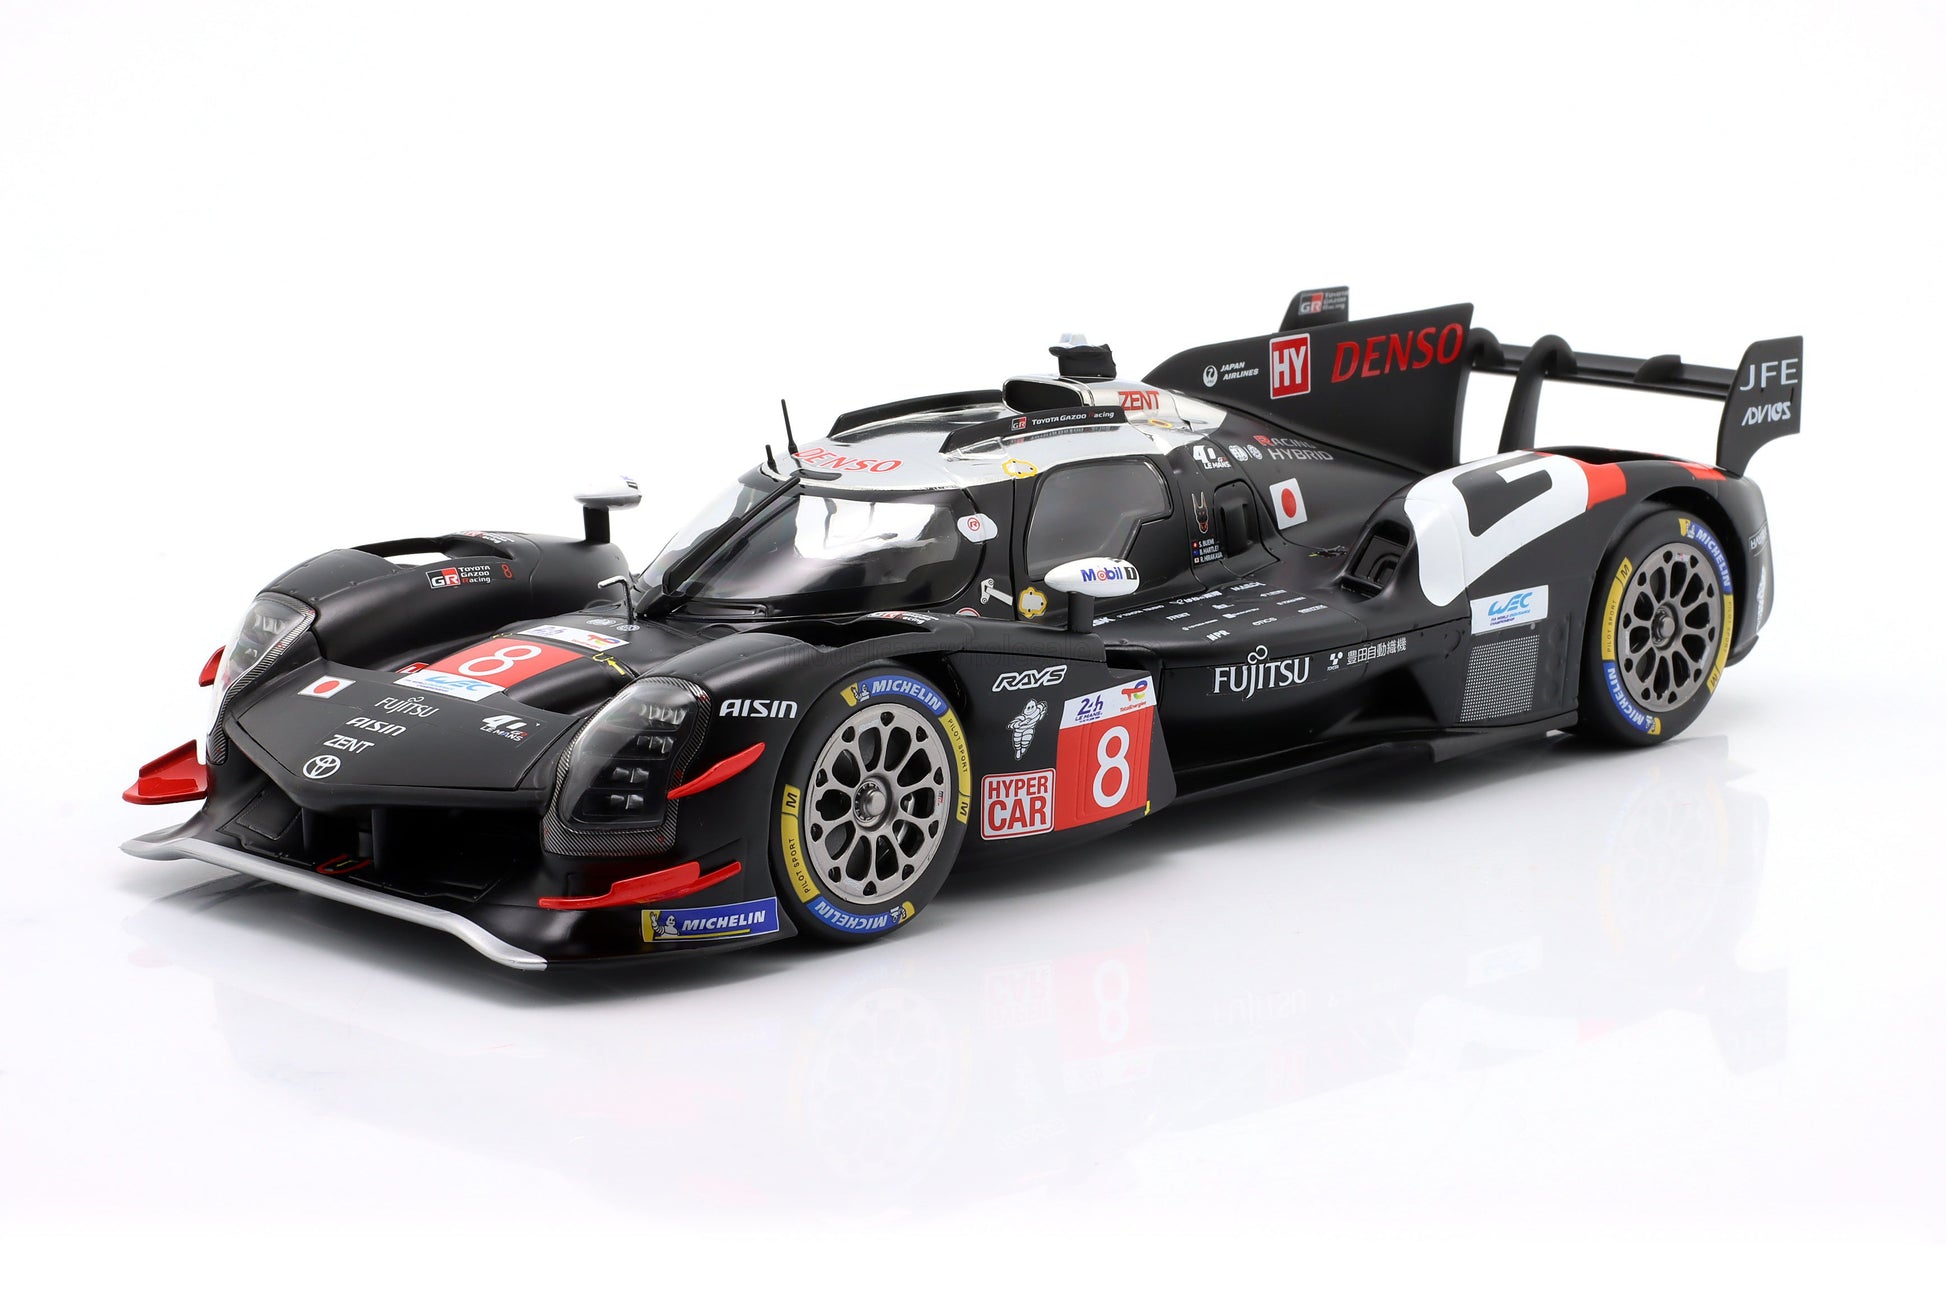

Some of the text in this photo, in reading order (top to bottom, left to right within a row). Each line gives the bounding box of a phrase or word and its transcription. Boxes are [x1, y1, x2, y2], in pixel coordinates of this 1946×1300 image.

[1300, 301, 1321, 313] GR
[1331, 323, 1463, 383] DENSO
[1220, 361, 1245, 372] JAPAN
[1223, 368, 1259, 381] AIRLINES
[1273, 346, 1306, 389] HY
[1740, 358, 1798, 391] JFE
[1118, 391, 1159, 410] ZENT
[1032, 417, 1060, 426] TOYOTA
[1060, 413, 1087, 422] GAZOO
[1089, 411, 1115, 419] Racing
[794, 447, 902, 473] DENSO
[1267, 447, 1334, 461] HYBRID
[1696, 529, 1731, 587] MICHELIN
[431, 574, 460, 587] GR
[502, 563, 513, 579] 8
[1080, 566, 1123, 582] Mobil
[1620, 564, 1630, 579] M
[1488, 592, 1533, 616] WEC
[458, 645, 542, 677] 8
[1214, 645, 1310, 698] FUJITSU
[992, 665, 1067, 692] RAYS
[872, 679, 942, 711] MICHELIN
[1607, 667, 1644, 725] MICHELIN
[374, 696, 440, 718] FUJITSU
[719, 699, 798, 719] AISIN
[346, 717, 407, 736] AISIN
[493, 729, 524, 742] MANS
[323, 734, 375, 754] ZENT
[947, 718, 968, 773] PILOT SPORT
[1093, 726, 1130, 808] 8
[988, 775, 1048, 800] HYPER
[786, 792, 798, 809] M
[960, 801, 969, 817] M
[988, 795, 1047, 832] CAR
[788, 838, 811, 894] PILOT SPORT
[682, 910, 766, 931] MICHELIN
[815, 901, 888, 930] MICHELIN
